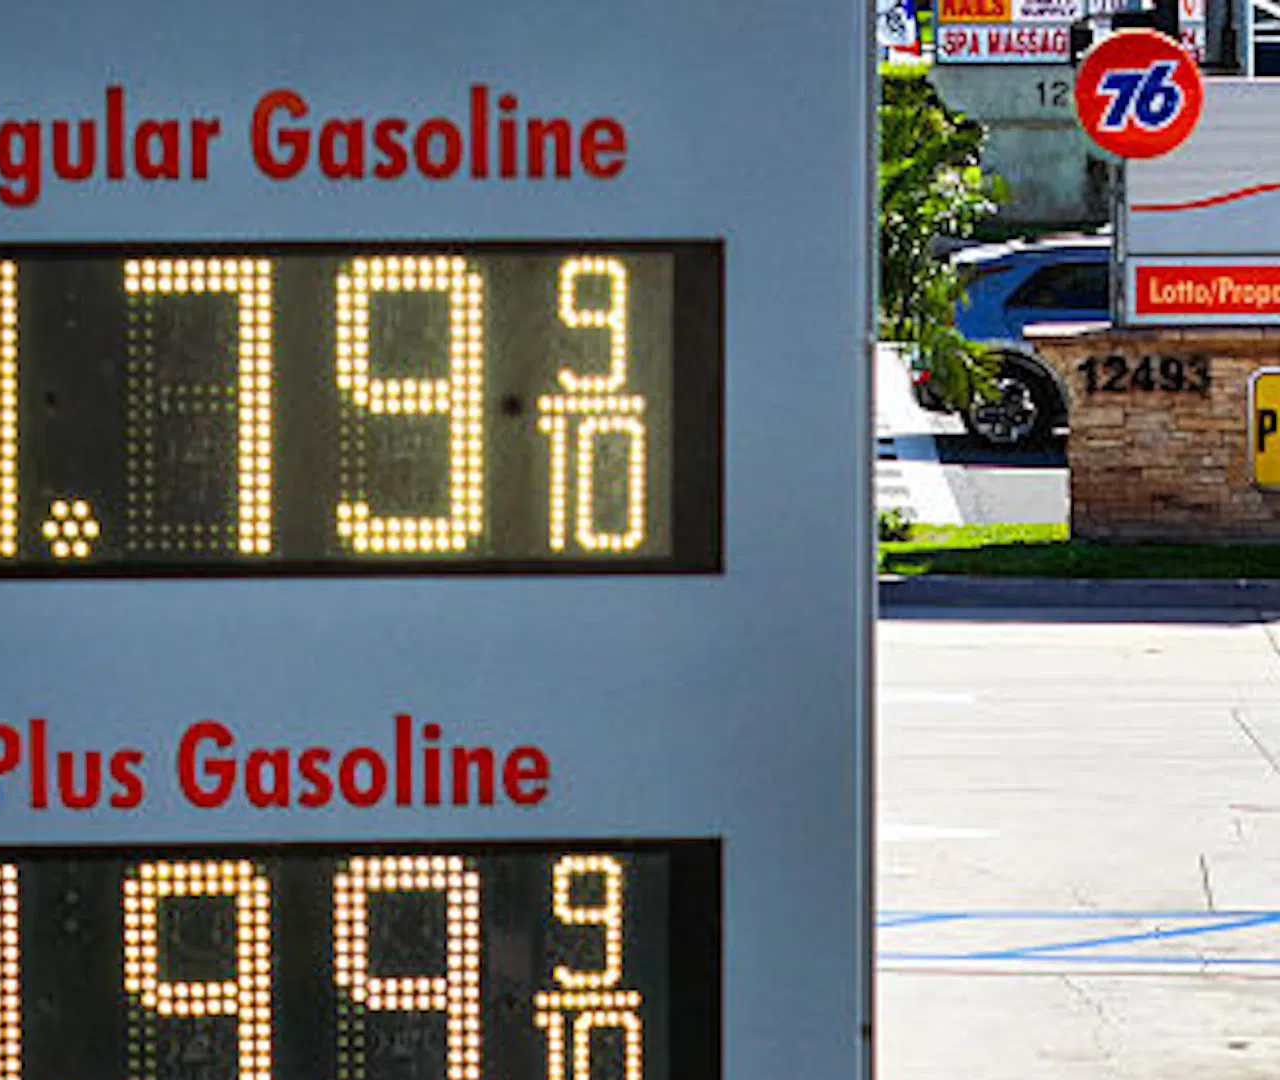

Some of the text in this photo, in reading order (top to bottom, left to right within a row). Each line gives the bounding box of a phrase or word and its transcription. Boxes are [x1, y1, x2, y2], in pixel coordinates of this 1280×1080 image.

[943, 29, 979, 54] SPA
[251, 84, 627, 180] Gasoline
[1096, 60, 1185, 132] 76
[1078, 356, 1211, 394] 12493
[176, 713, 550, 809] Gasoline
